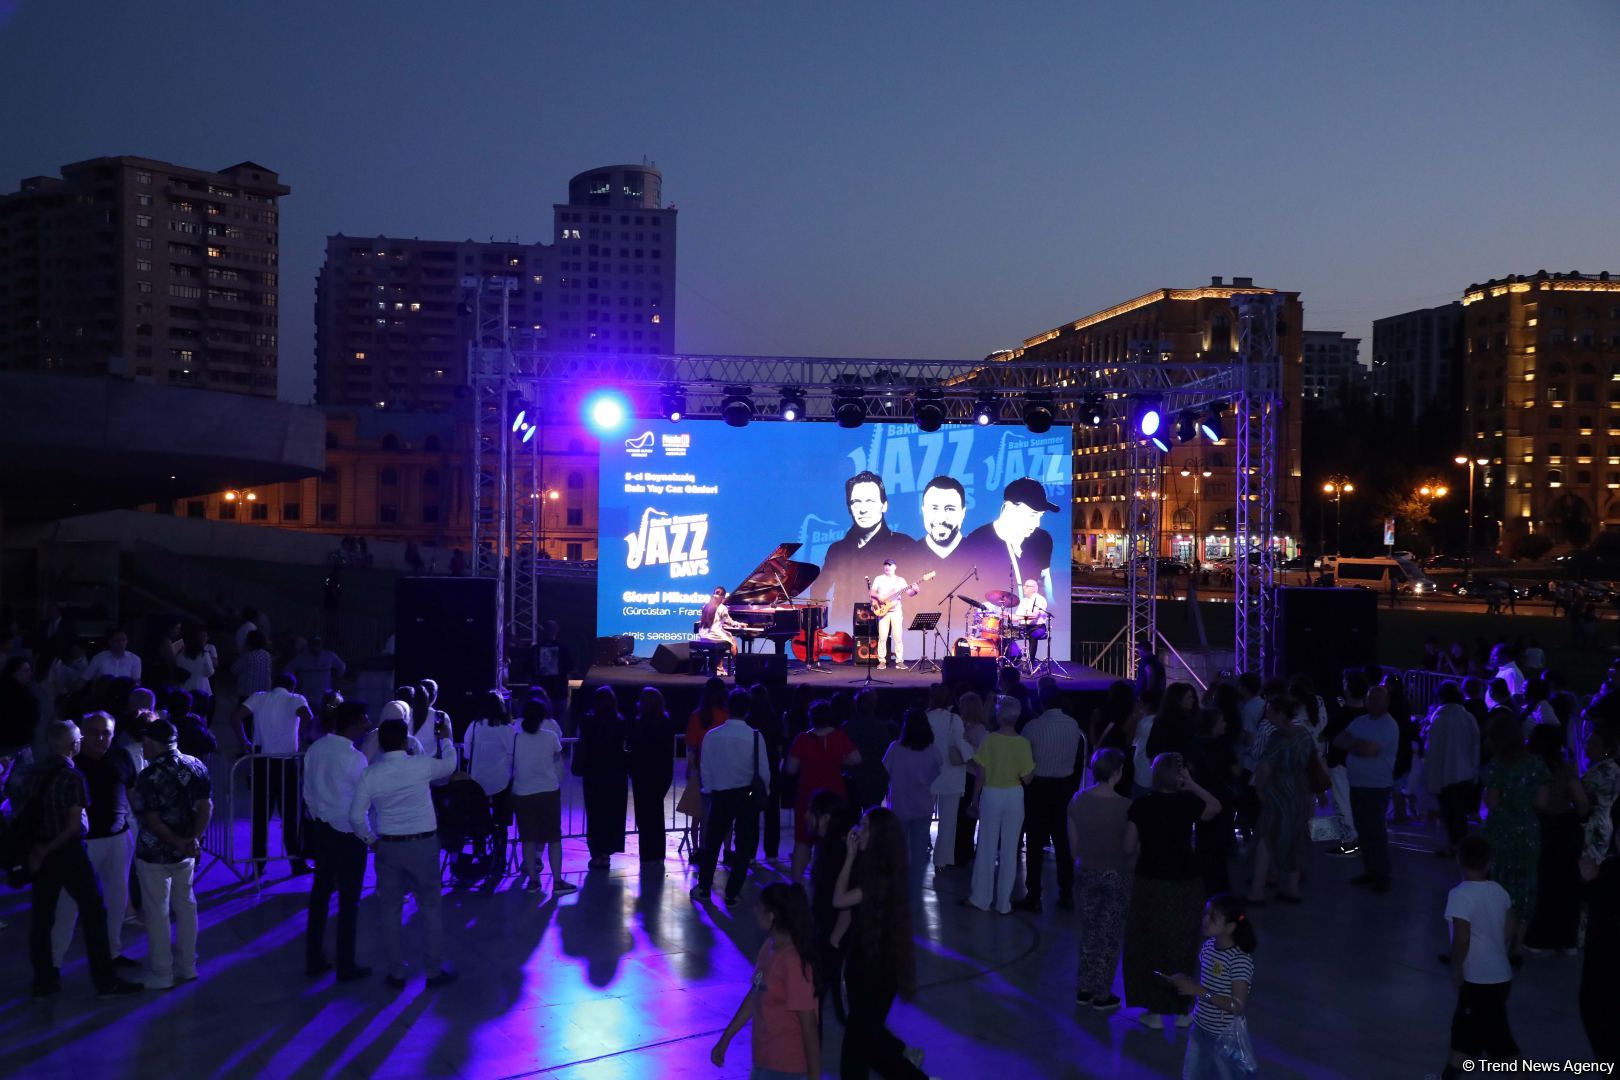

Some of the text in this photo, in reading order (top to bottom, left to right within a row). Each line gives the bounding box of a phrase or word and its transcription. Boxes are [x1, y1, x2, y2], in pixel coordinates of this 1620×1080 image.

[887, 423, 919, 437] Baku
[1008, 436, 1064, 449] Baku Summer
[624, 506, 709, 570] JAZZ
[812, 528, 845, 544] Baku
[669, 560, 710, 578] DAYS
[622, 606, 671, 617] (Gürcüstan
